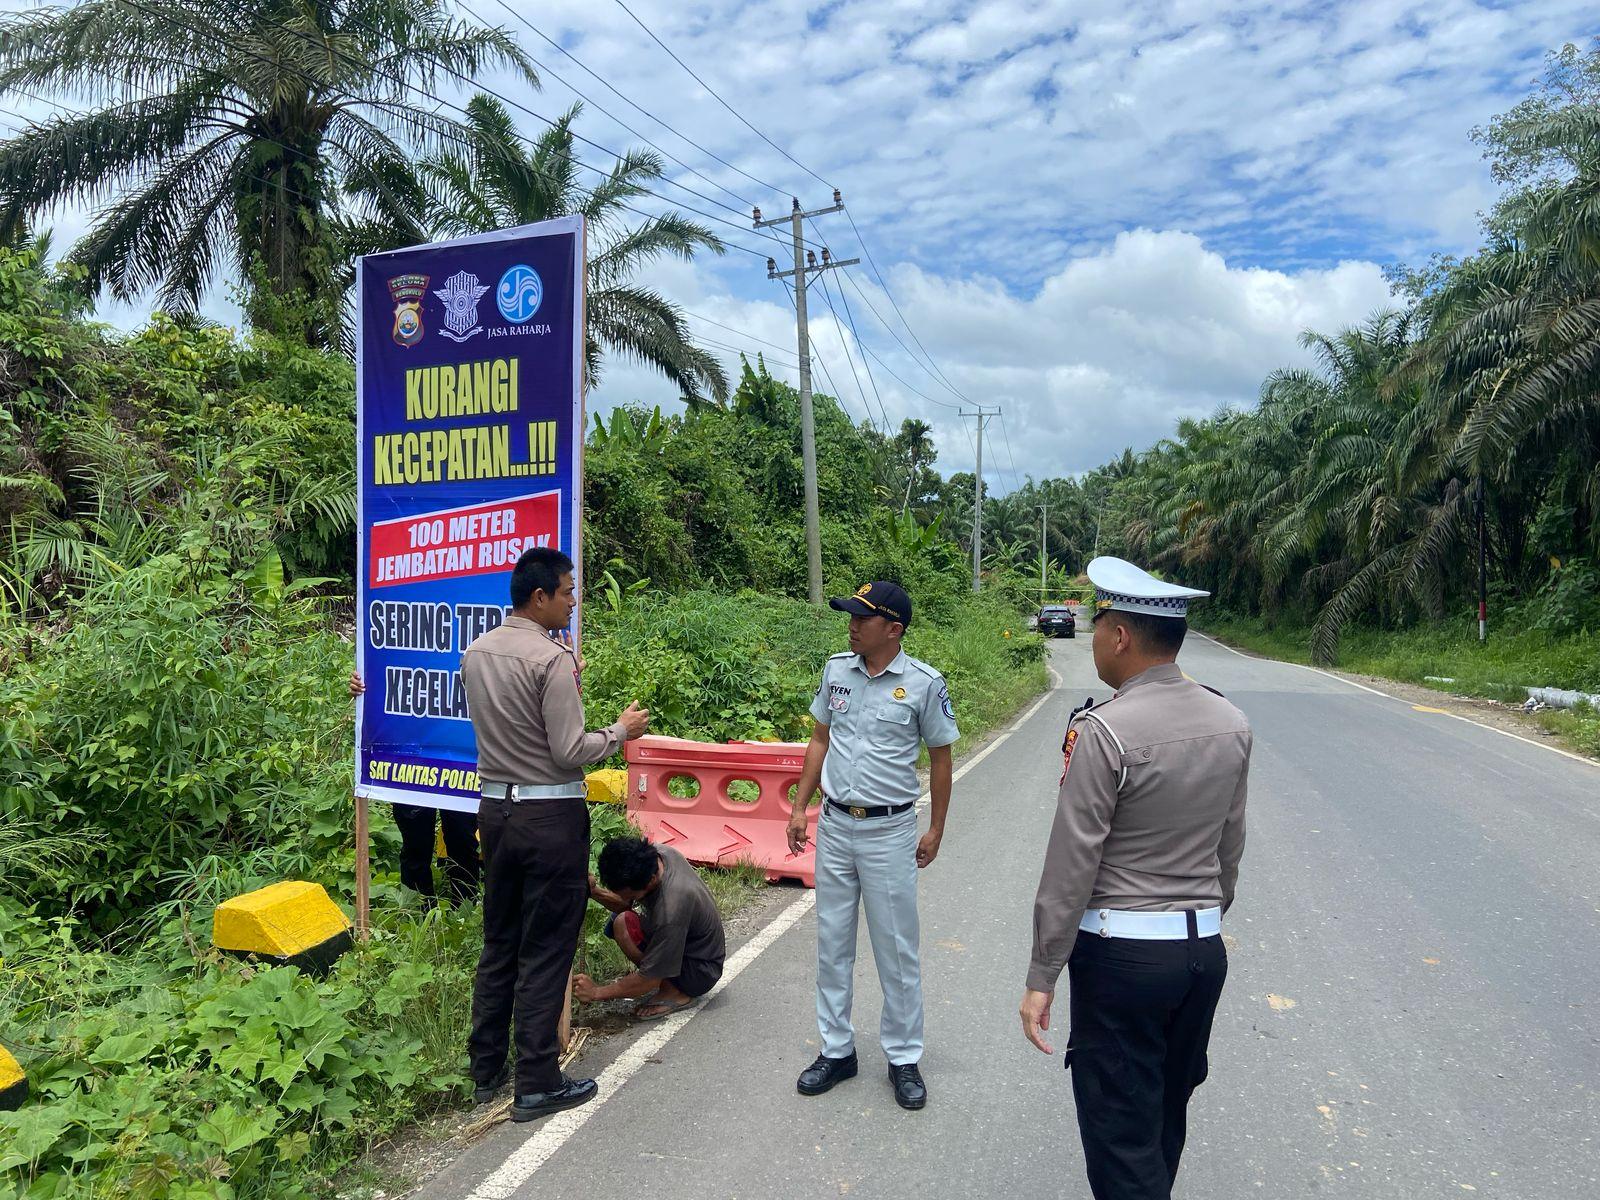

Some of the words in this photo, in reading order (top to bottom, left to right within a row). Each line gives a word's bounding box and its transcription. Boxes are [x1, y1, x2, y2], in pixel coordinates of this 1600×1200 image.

[488, 327, 508, 339] JASA
[509, 324, 552, 337] RAHARJA
[405, 357, 519, 421] KURANGI
[374, 421, 557, 485] KECEPATAN...!!!
[408, 520, 444, 549] 100
[448, 508, 516, 543] METER
[376, 544, 474, 582] JEMBATAN
[370, 600, 453, 653] SERING
[385, 666, 472, 721] KECELA
[369, 760, 391, 780] SAT
[391, 763, 439, 787] LANTAS
[439, 768, 482, 792] POLRE
